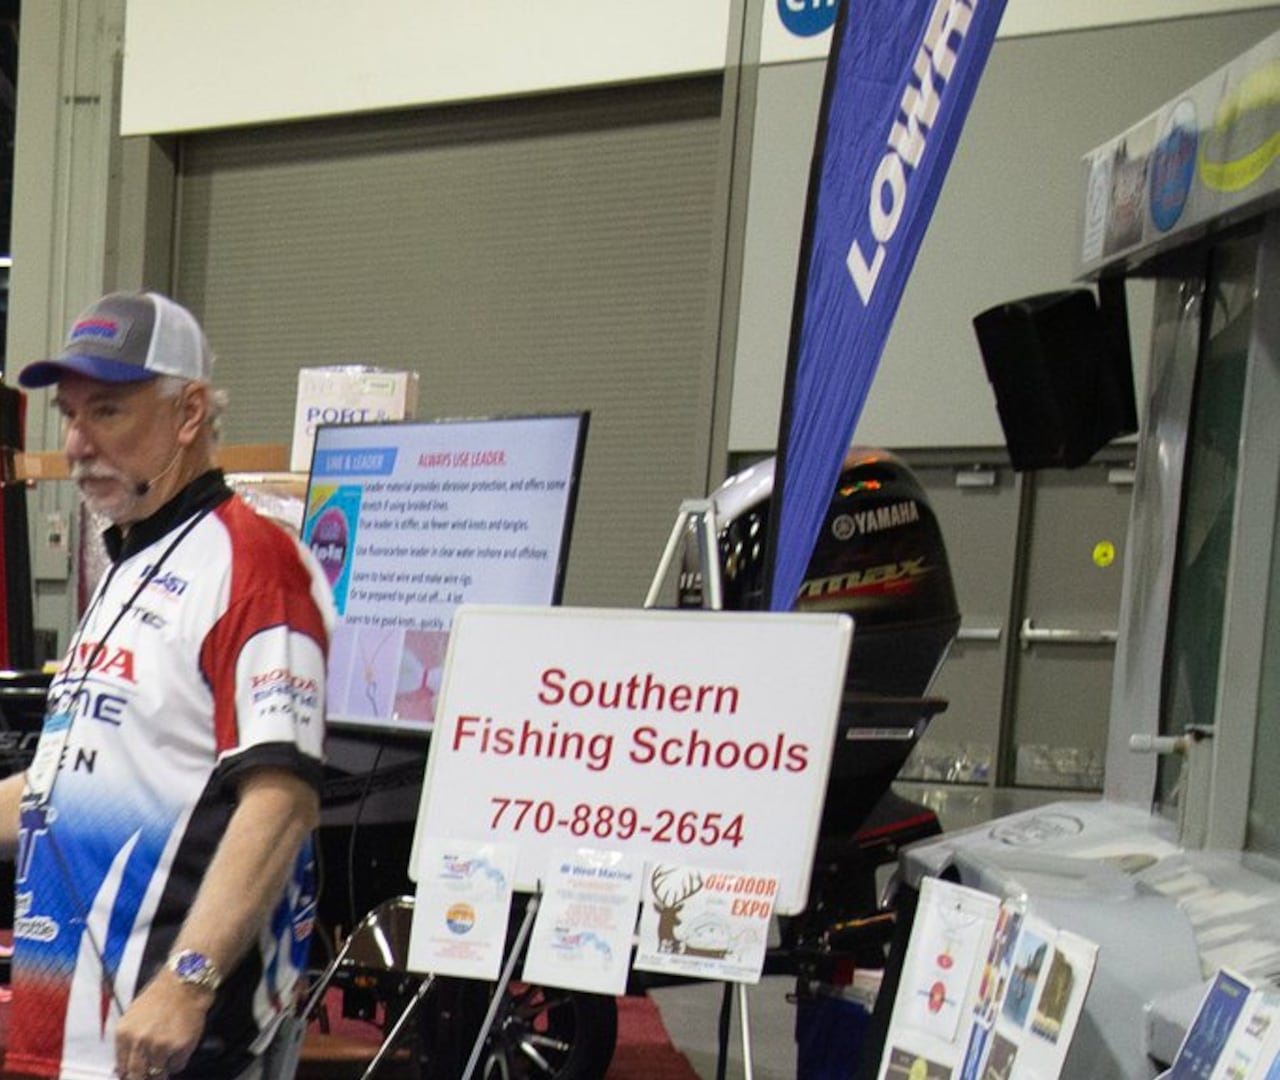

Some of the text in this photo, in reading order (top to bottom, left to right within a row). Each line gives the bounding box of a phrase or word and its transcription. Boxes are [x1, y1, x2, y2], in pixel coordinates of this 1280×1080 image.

[855, 500, 920, 535] YAMAHA
[538, 667, 740, 717] Southern
[452, 715, 811, 774] Fishing Schools
[490, 797, 746, 849] 770-889-2654
[730, 898, 771, 920] EXPO
